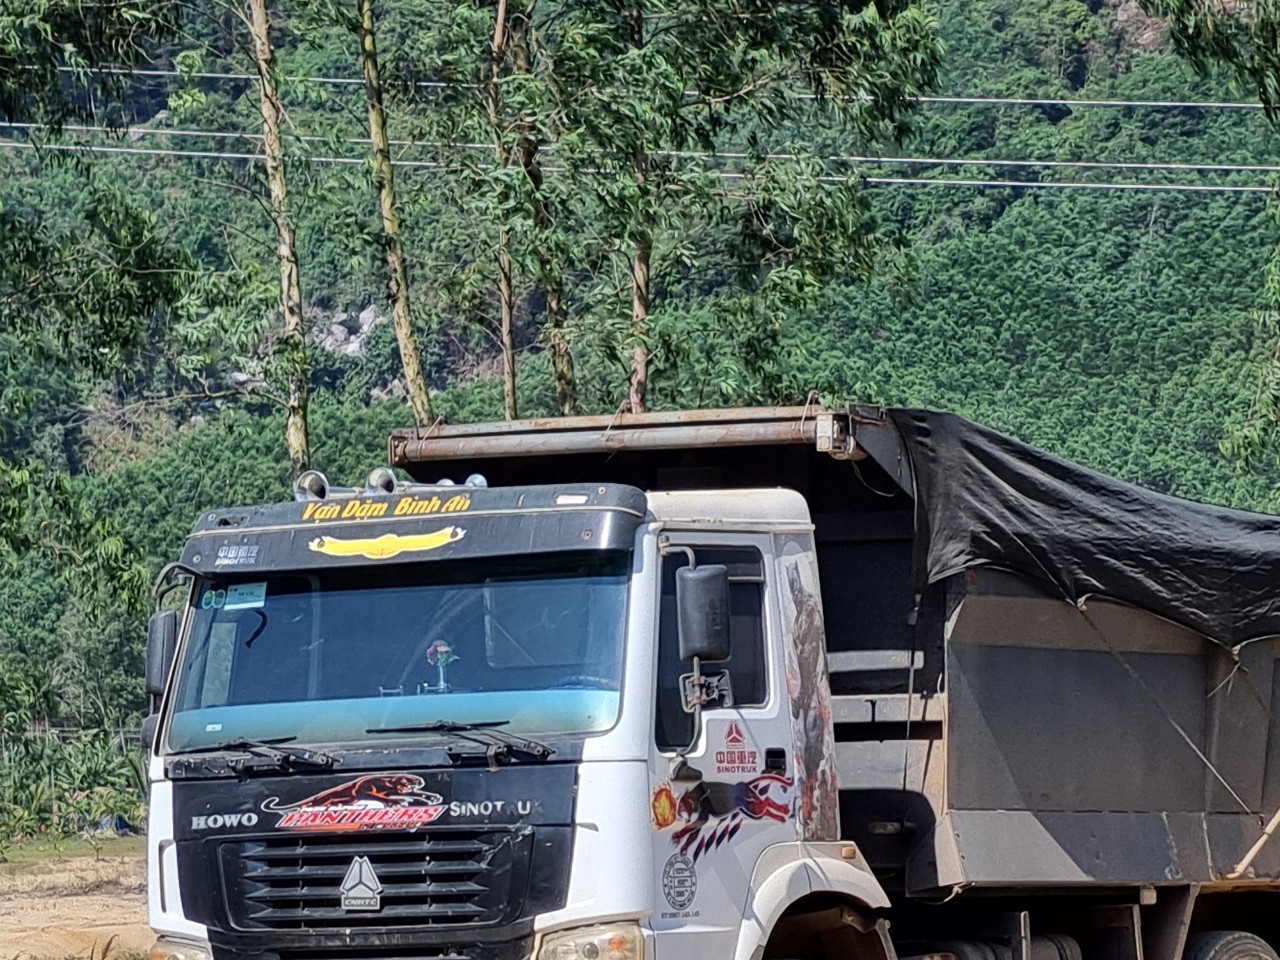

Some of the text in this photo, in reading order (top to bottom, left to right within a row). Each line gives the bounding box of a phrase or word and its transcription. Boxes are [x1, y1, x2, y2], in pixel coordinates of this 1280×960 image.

[302, 502, 341, 525] Vạn
[716, 765, 758, 774] SINOTRUK
[191, 812, 259, 830] HOWO
[281, 806, 441, 827] PANTHERS
[344, 898, 377, 906] CNHTC
